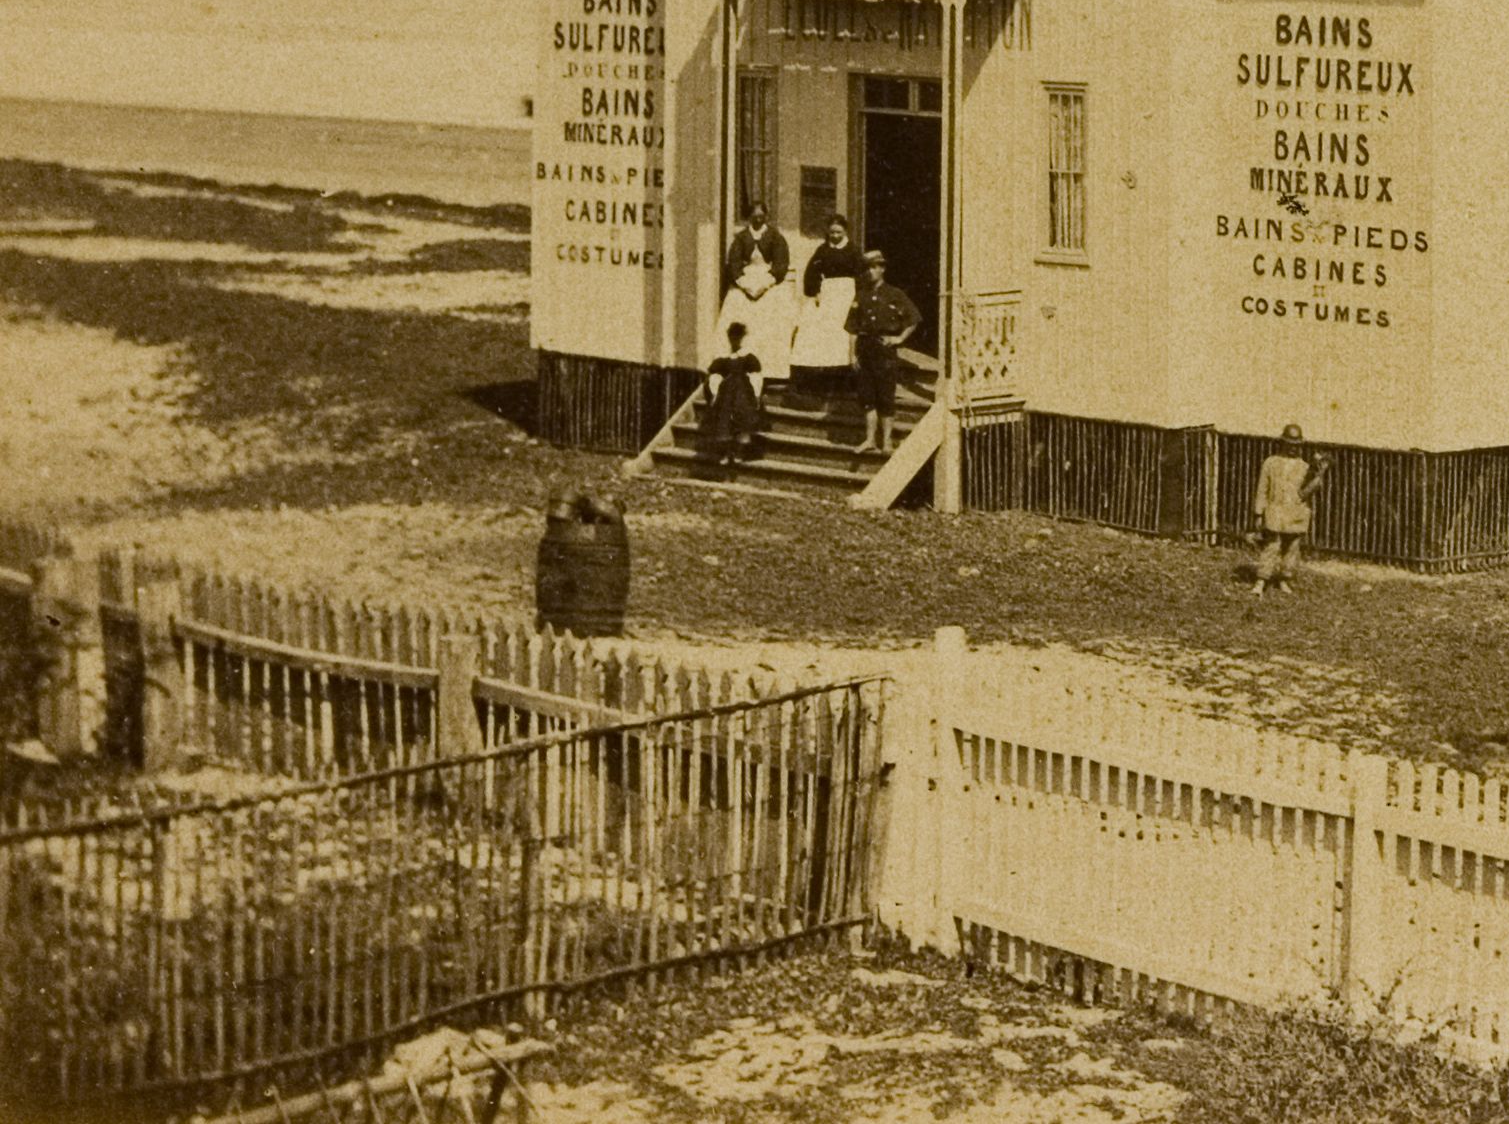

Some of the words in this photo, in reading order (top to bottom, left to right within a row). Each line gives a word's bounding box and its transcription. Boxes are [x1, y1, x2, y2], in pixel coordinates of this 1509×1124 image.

[554, 22, 665, 56] SULFURE
[1276, 14, 1373, 48] BAINS
[1237, 53, 1415, 96] SULFUREUX
[582, 87, 655, 119] BAINS
[1275, 130, 1370, 166] BAINS
[536, 162, 605, 183] BAINS
[627, 167, 664, 188] PIE
[1217, 215, 1305, 243] BAINS
[1333, 224, 1429, 252] PIEDS
[1253, 254, 1387, 287] CABINES
[1241, 296, 1390, 328] COSTUMES
